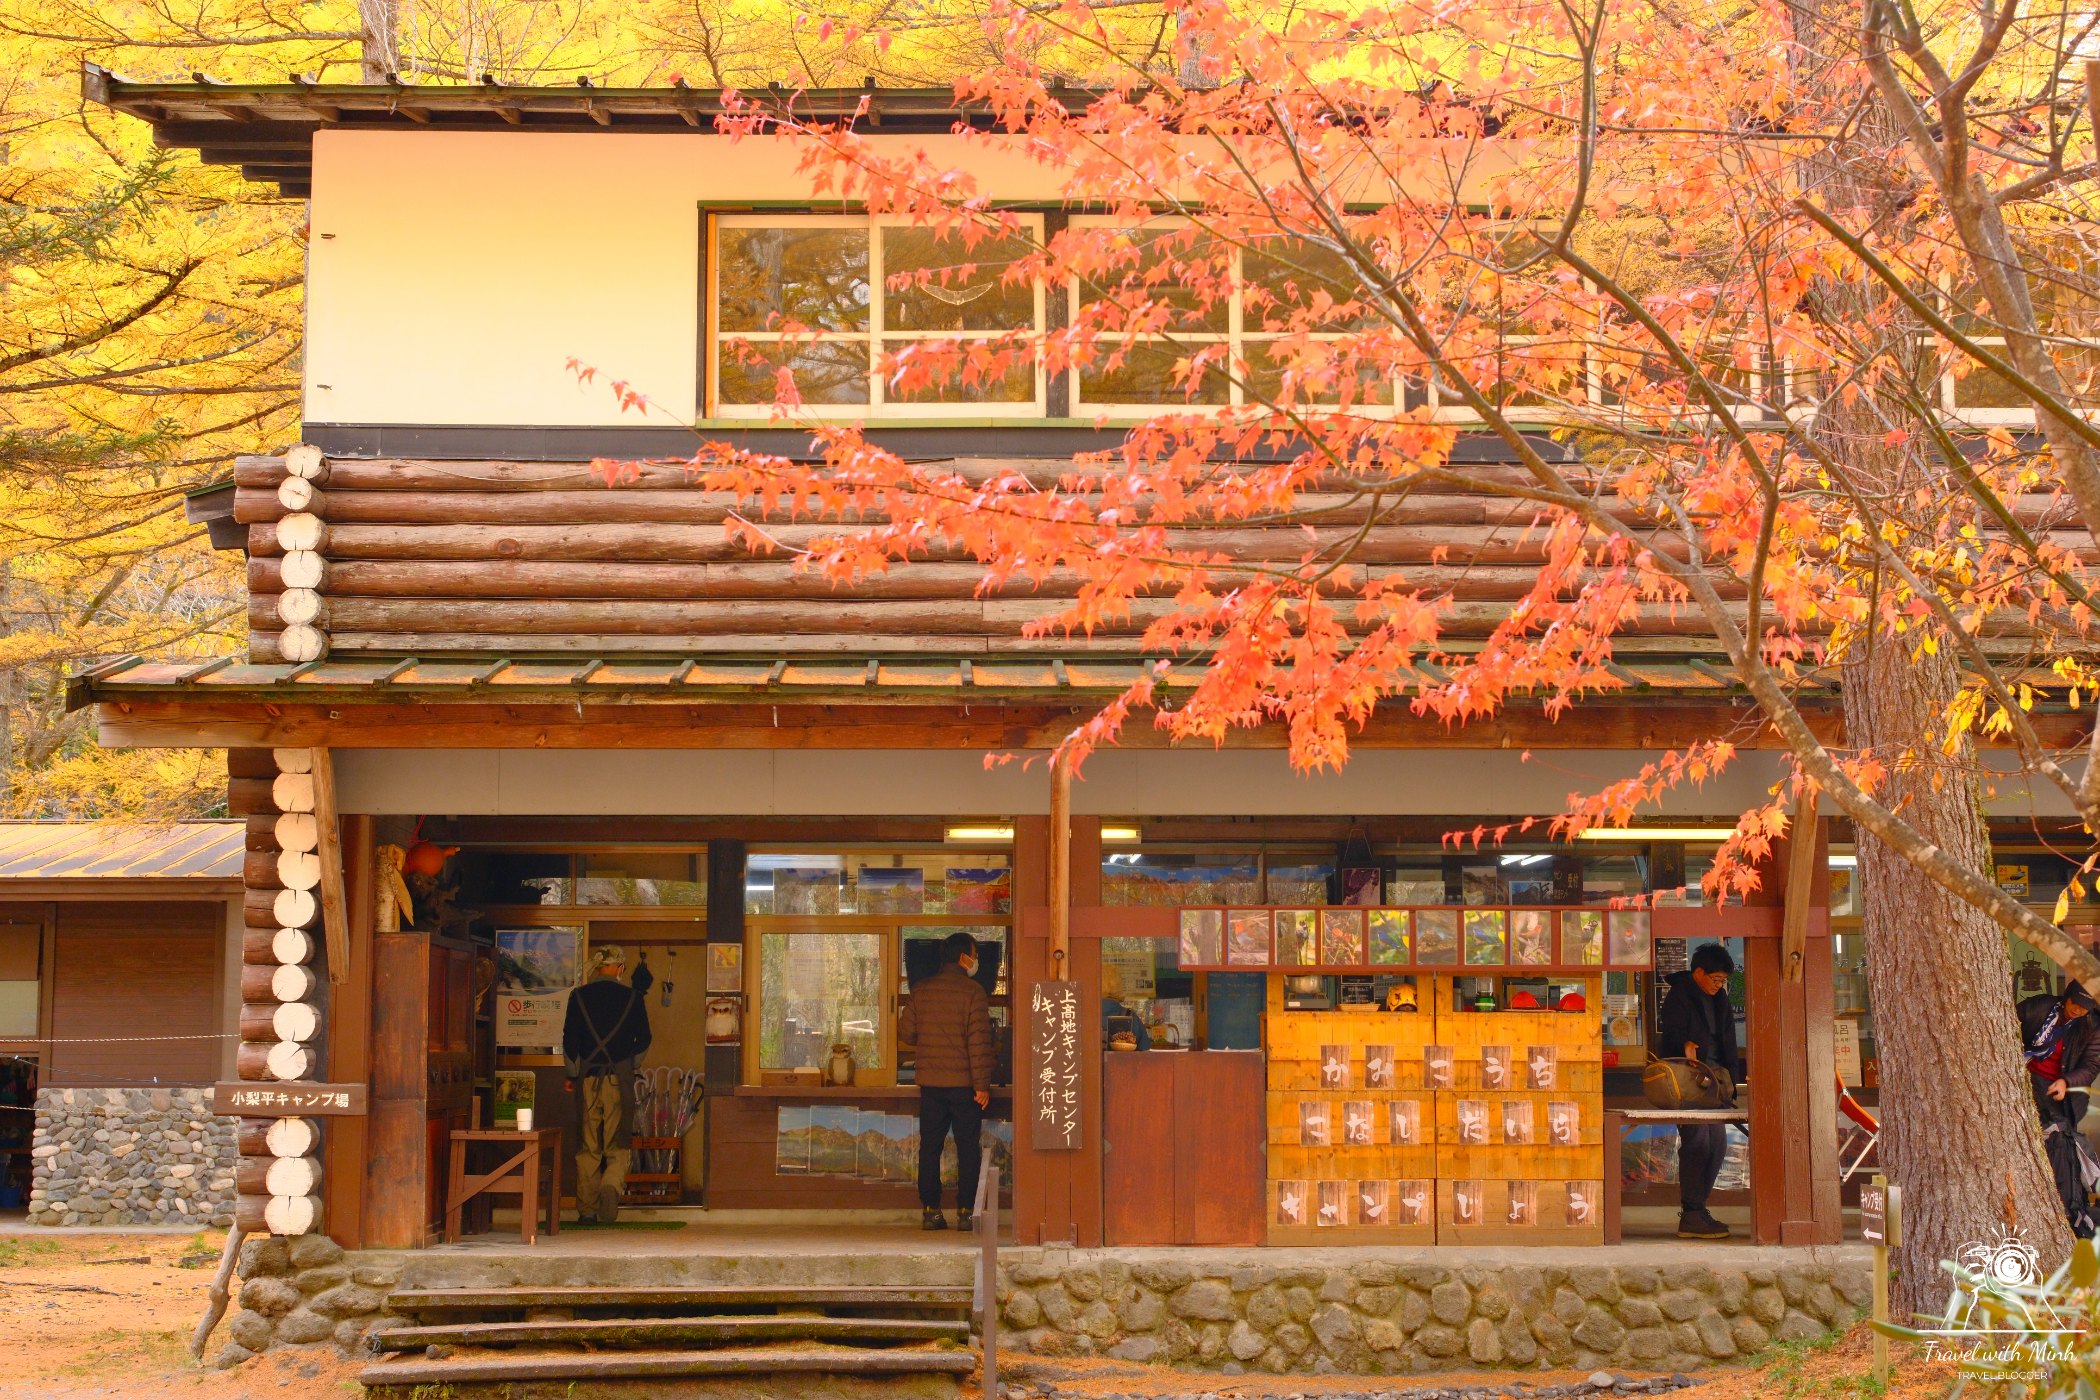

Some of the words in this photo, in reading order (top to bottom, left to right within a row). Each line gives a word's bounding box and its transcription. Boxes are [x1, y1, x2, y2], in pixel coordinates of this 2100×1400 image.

[1039, 996, 1058, 1125] キャンプ受付所
[1322, 1055, 1554, 1087] かみこうち
[231, 1091, 350, 1108] 小梨平キャンプ場
